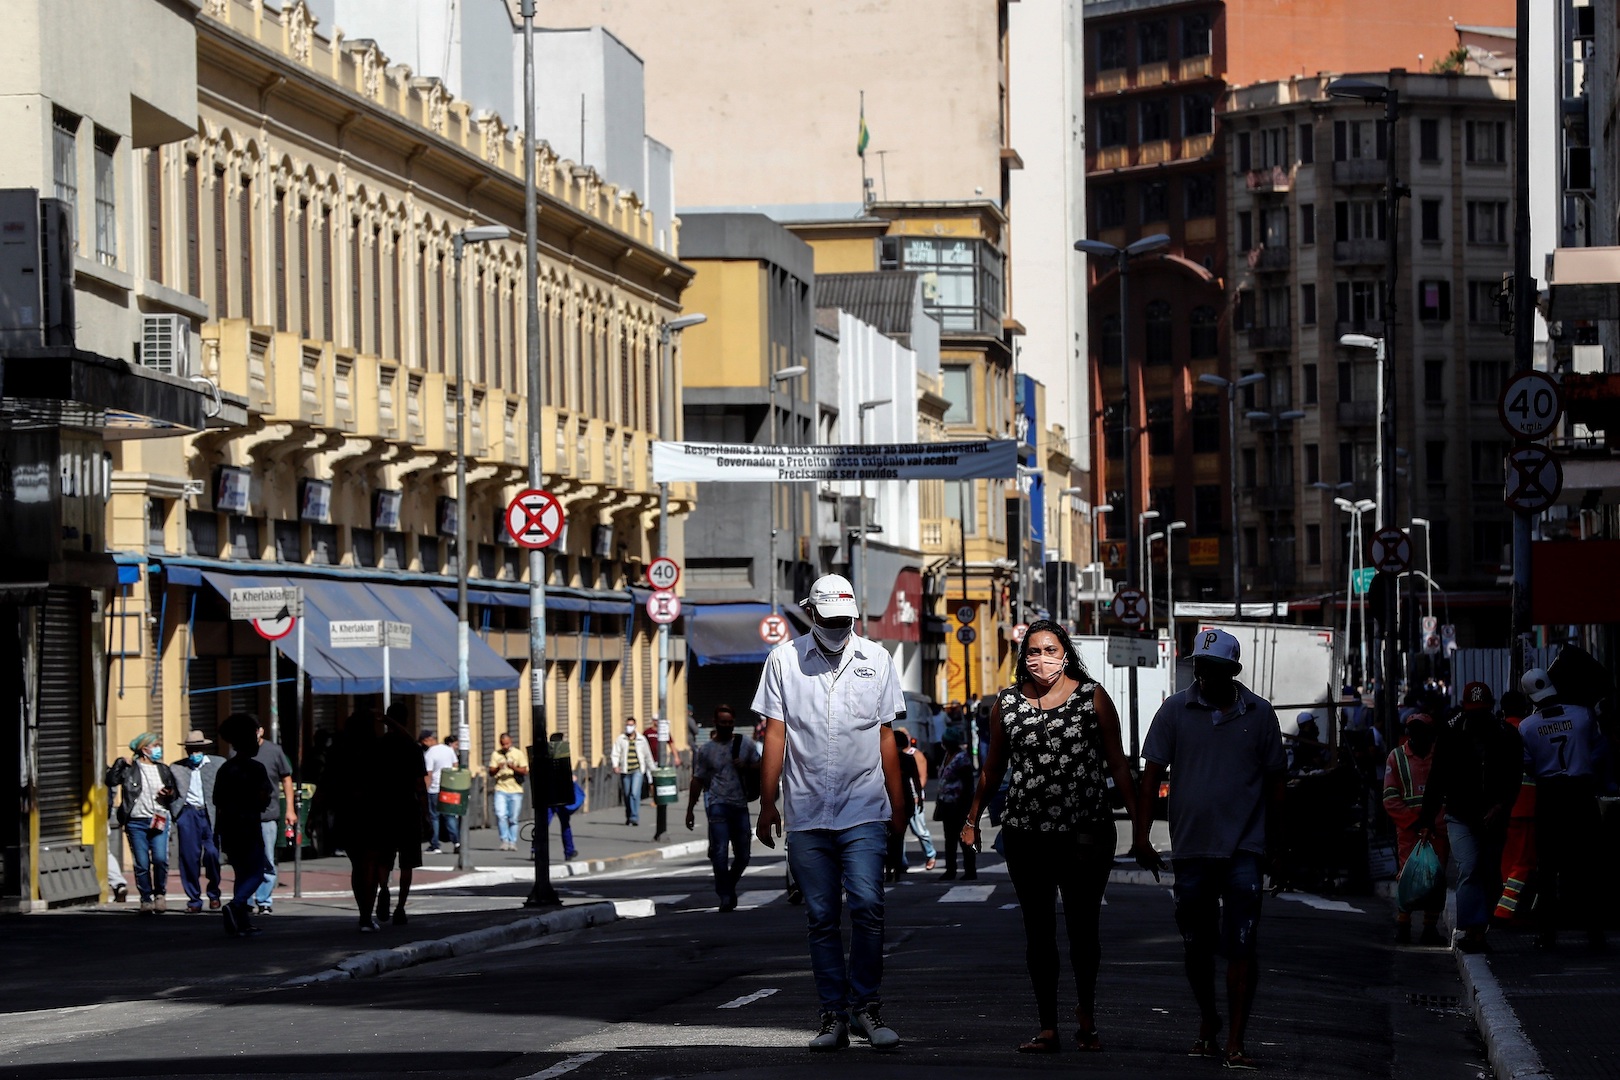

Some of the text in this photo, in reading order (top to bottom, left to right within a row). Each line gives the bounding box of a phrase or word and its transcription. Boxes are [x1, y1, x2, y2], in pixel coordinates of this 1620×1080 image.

[1508, 388, 1553, 419] 40
[684, 444, 751, 457] Respeitamos
[846, 445, 881, 457] chegar
[717, 456, 776, 467] Governador
[778, 459, 785, 468] e
[787, 457, 827, 468] Prefeito
[907, 456, 922, 466] vai
[923, 455, 959, 466] acabar
[778, 468, 898, 480] Precisamos ser ouvidos
[653, 565, 675, 579] 40
[232, 591, 241, 602] A.
[958, 608, 973, 618] 40
[331, 624, 338, 633] A.
[1537, 720, 1573, 737] RONALDO
[1549, 735, 1568, 771] 7
